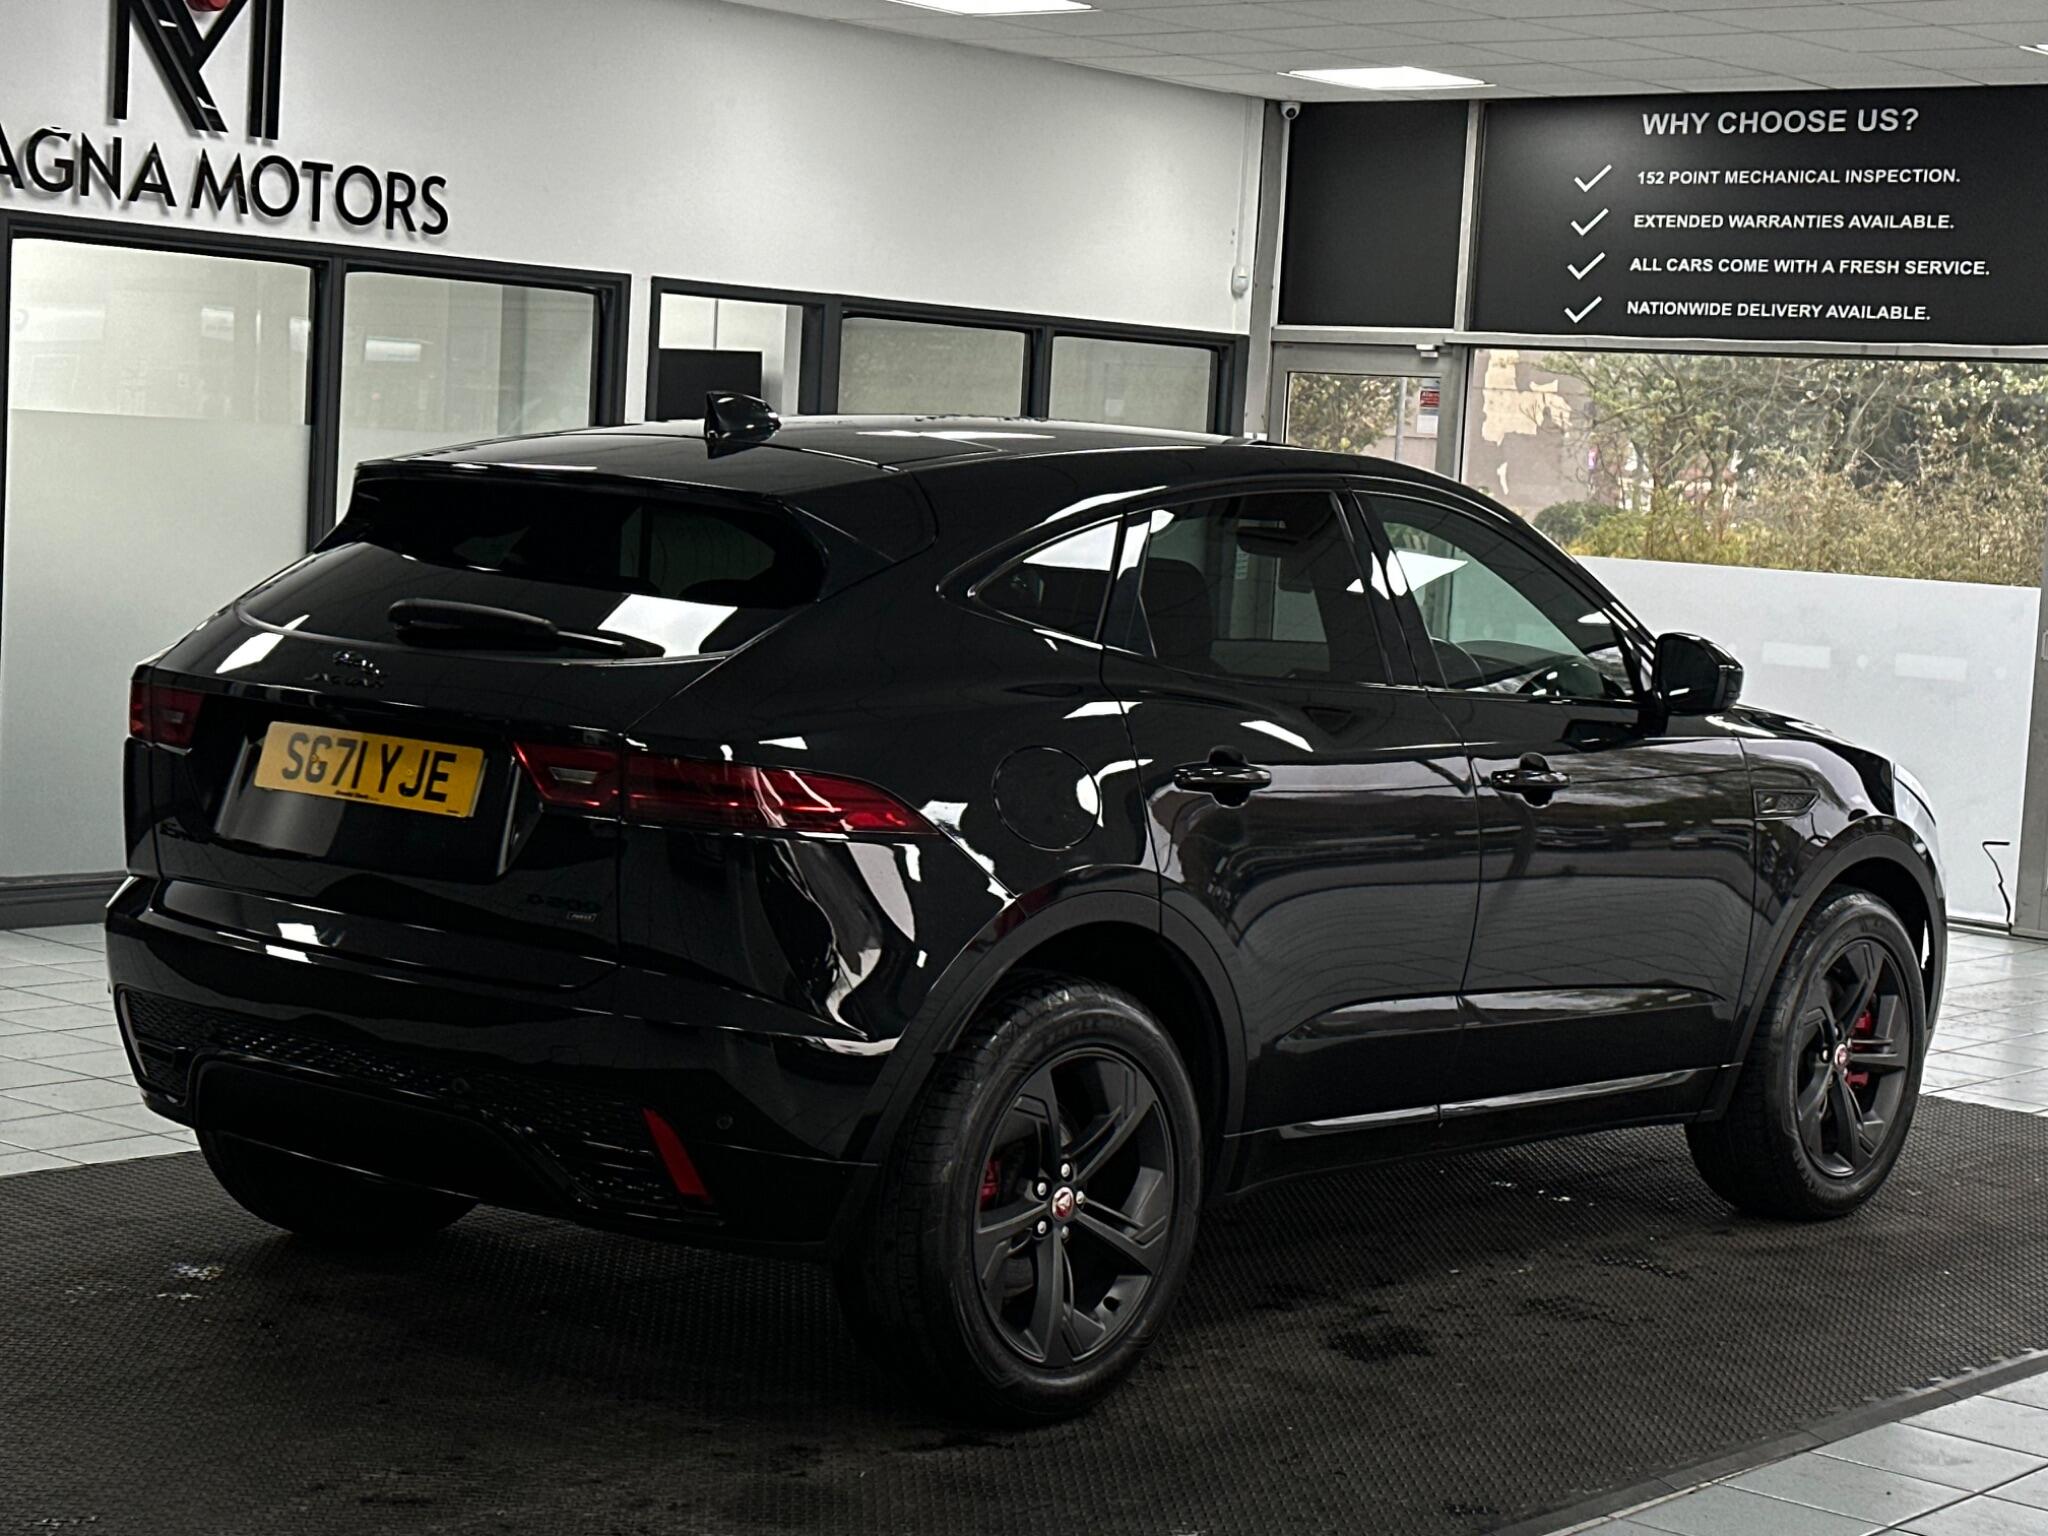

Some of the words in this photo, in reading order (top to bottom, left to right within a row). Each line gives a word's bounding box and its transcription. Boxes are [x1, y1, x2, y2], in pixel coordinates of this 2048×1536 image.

[1642, 112, 1710, 136] WHY
[1717, 109, 1847, 134] CHOOSE
[1857, 108, 1919, 132] US?
[1637, 170, 1665, 185] 152
[1668, 170, 1721, 185] POINT
[1724, 169, 1841, 185] MECHANICAL
[1845, 168, 1961, 184] INSPECTION.
[191, 148, 449, 235] MOTORS
[1633, 214, 1724, 229] EXTENDED
[1728, 214, 1845, 229] WARRANTIES
[1848, 214, 1955, 229] AVAILABLE.
[1629, 257, 1663, 272] ALL
[1666, 257, 1714, 272] CARS
[1718, 258, 1770, 273] COME
[1773, 259, 1818, 274] WITH
[1821, 259, 1835, 274] A
[1839, 259, 1900, 275] FRESH
[1904, 260, 1990, 276] SERVICE.
[1626, 300, 1733, 316] NATIONWIDE
[1736, 302, 1823, 318] DELIVERY
[1825, 304, 1931, 321] AVAILABLE.
[281, 732, 369, 790] SG71
[378, 743, 458, 803] YJE
